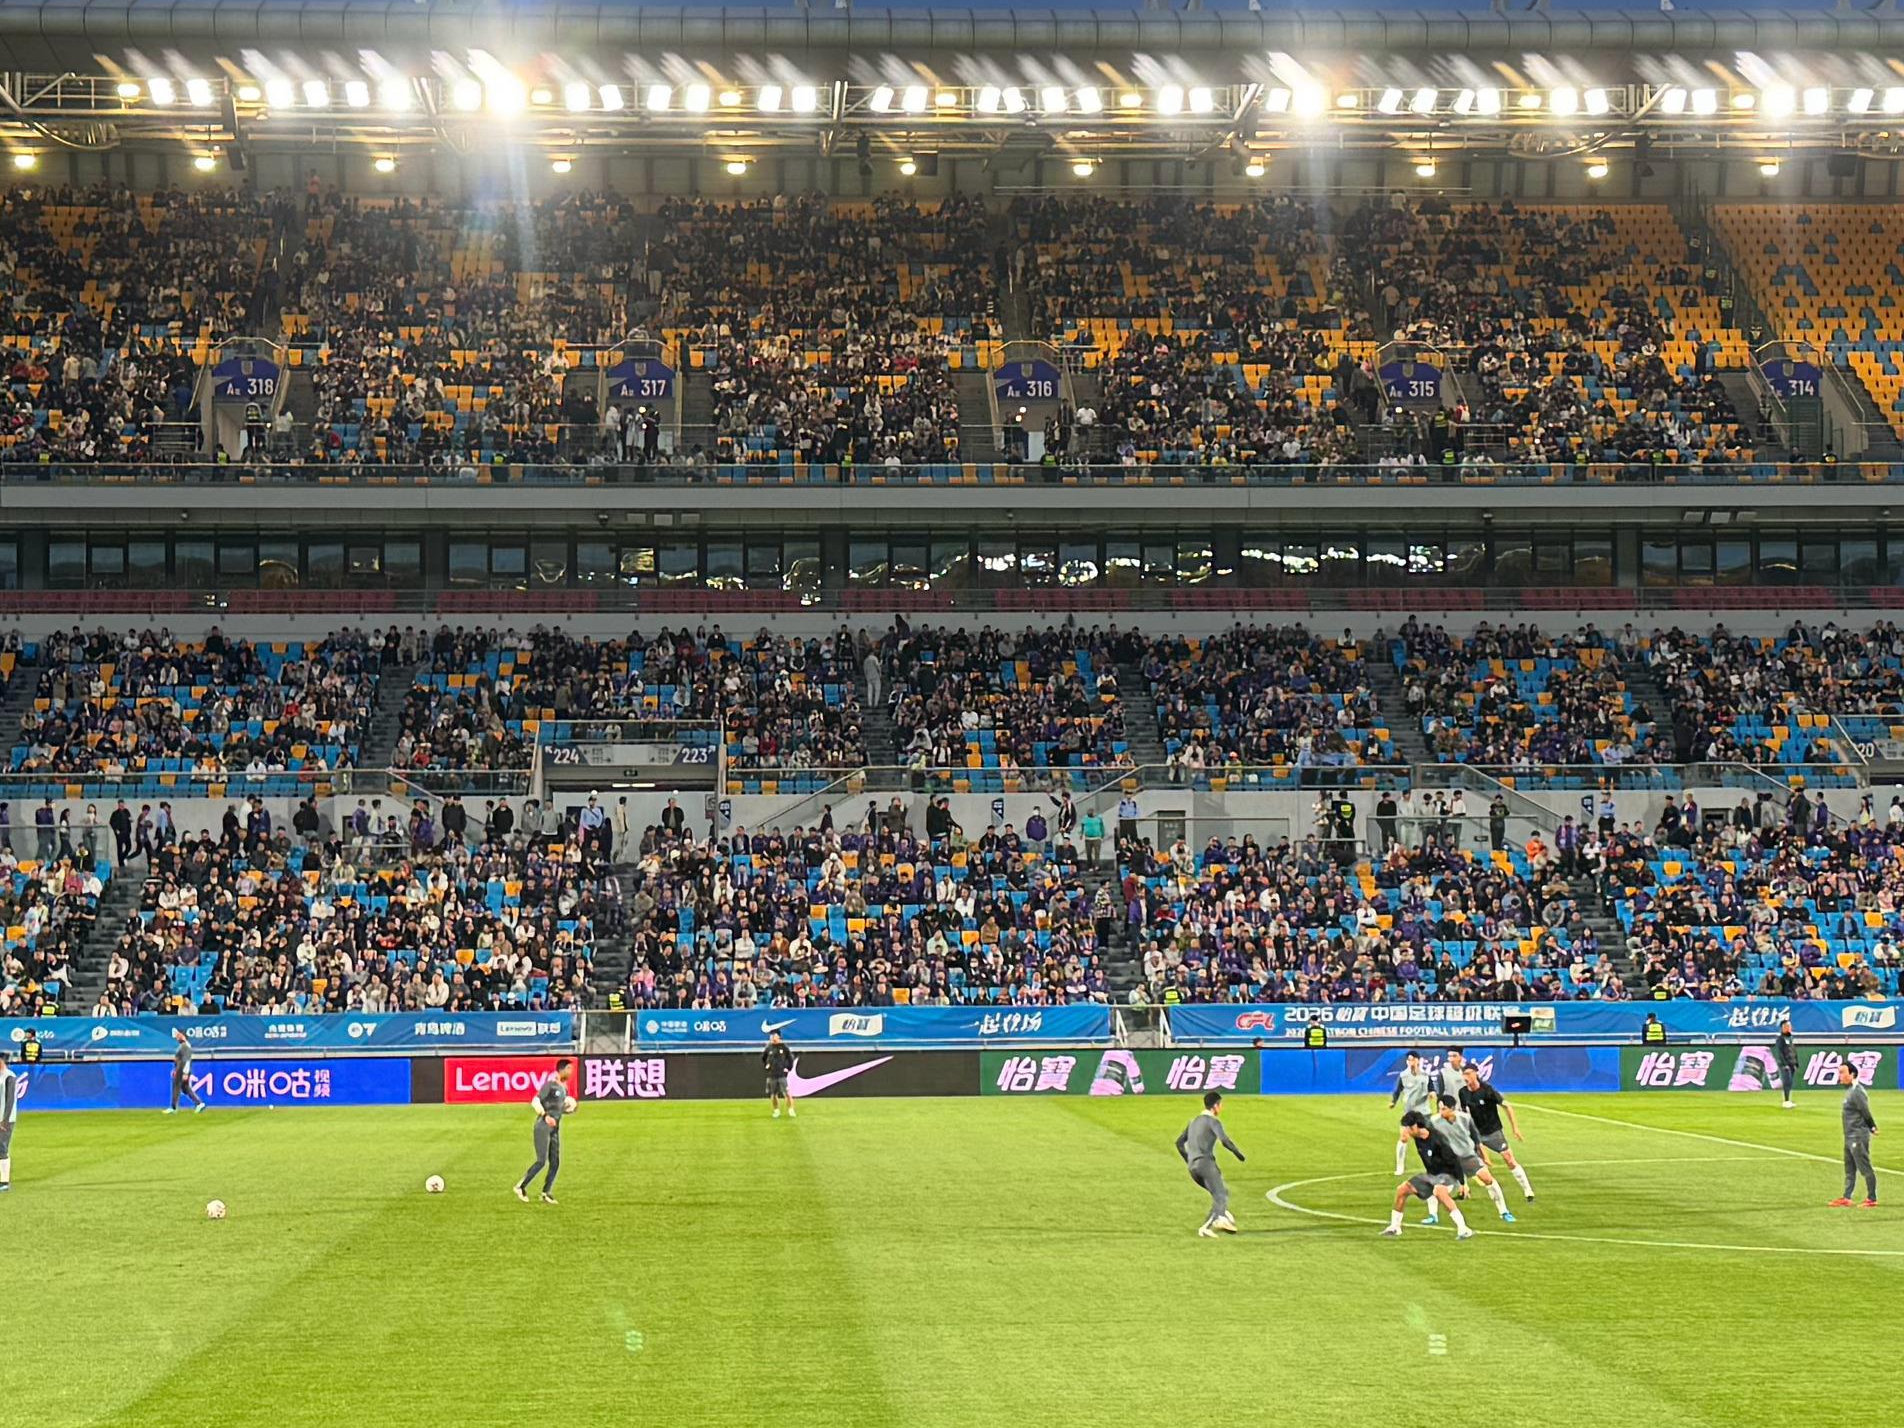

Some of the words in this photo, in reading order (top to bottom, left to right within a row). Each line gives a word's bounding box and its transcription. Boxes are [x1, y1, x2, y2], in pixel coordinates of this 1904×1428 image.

[247, 378, 274, 395] 318
[640, 379, 666, 396] 317
[1026, 380, 1052, 397] 316
[1408, 380, 1434, 397] 315
[1788, 379, 1814, 396] 314
[553, 749, 580, 765] 224
[681, 749, 706, 765] 223
[1399, 1025, 1451, 1036] FOOTBALL
[996, 1056, 1077, 1093] 怡寶
[1165, 1054, 1246, 1091] 怡寶
[1636, 1051, 1715, 1087] 怡寶
[223, 1068, 312, 1099] 咪咕
[584, 1058, 666, 1098] 联想
